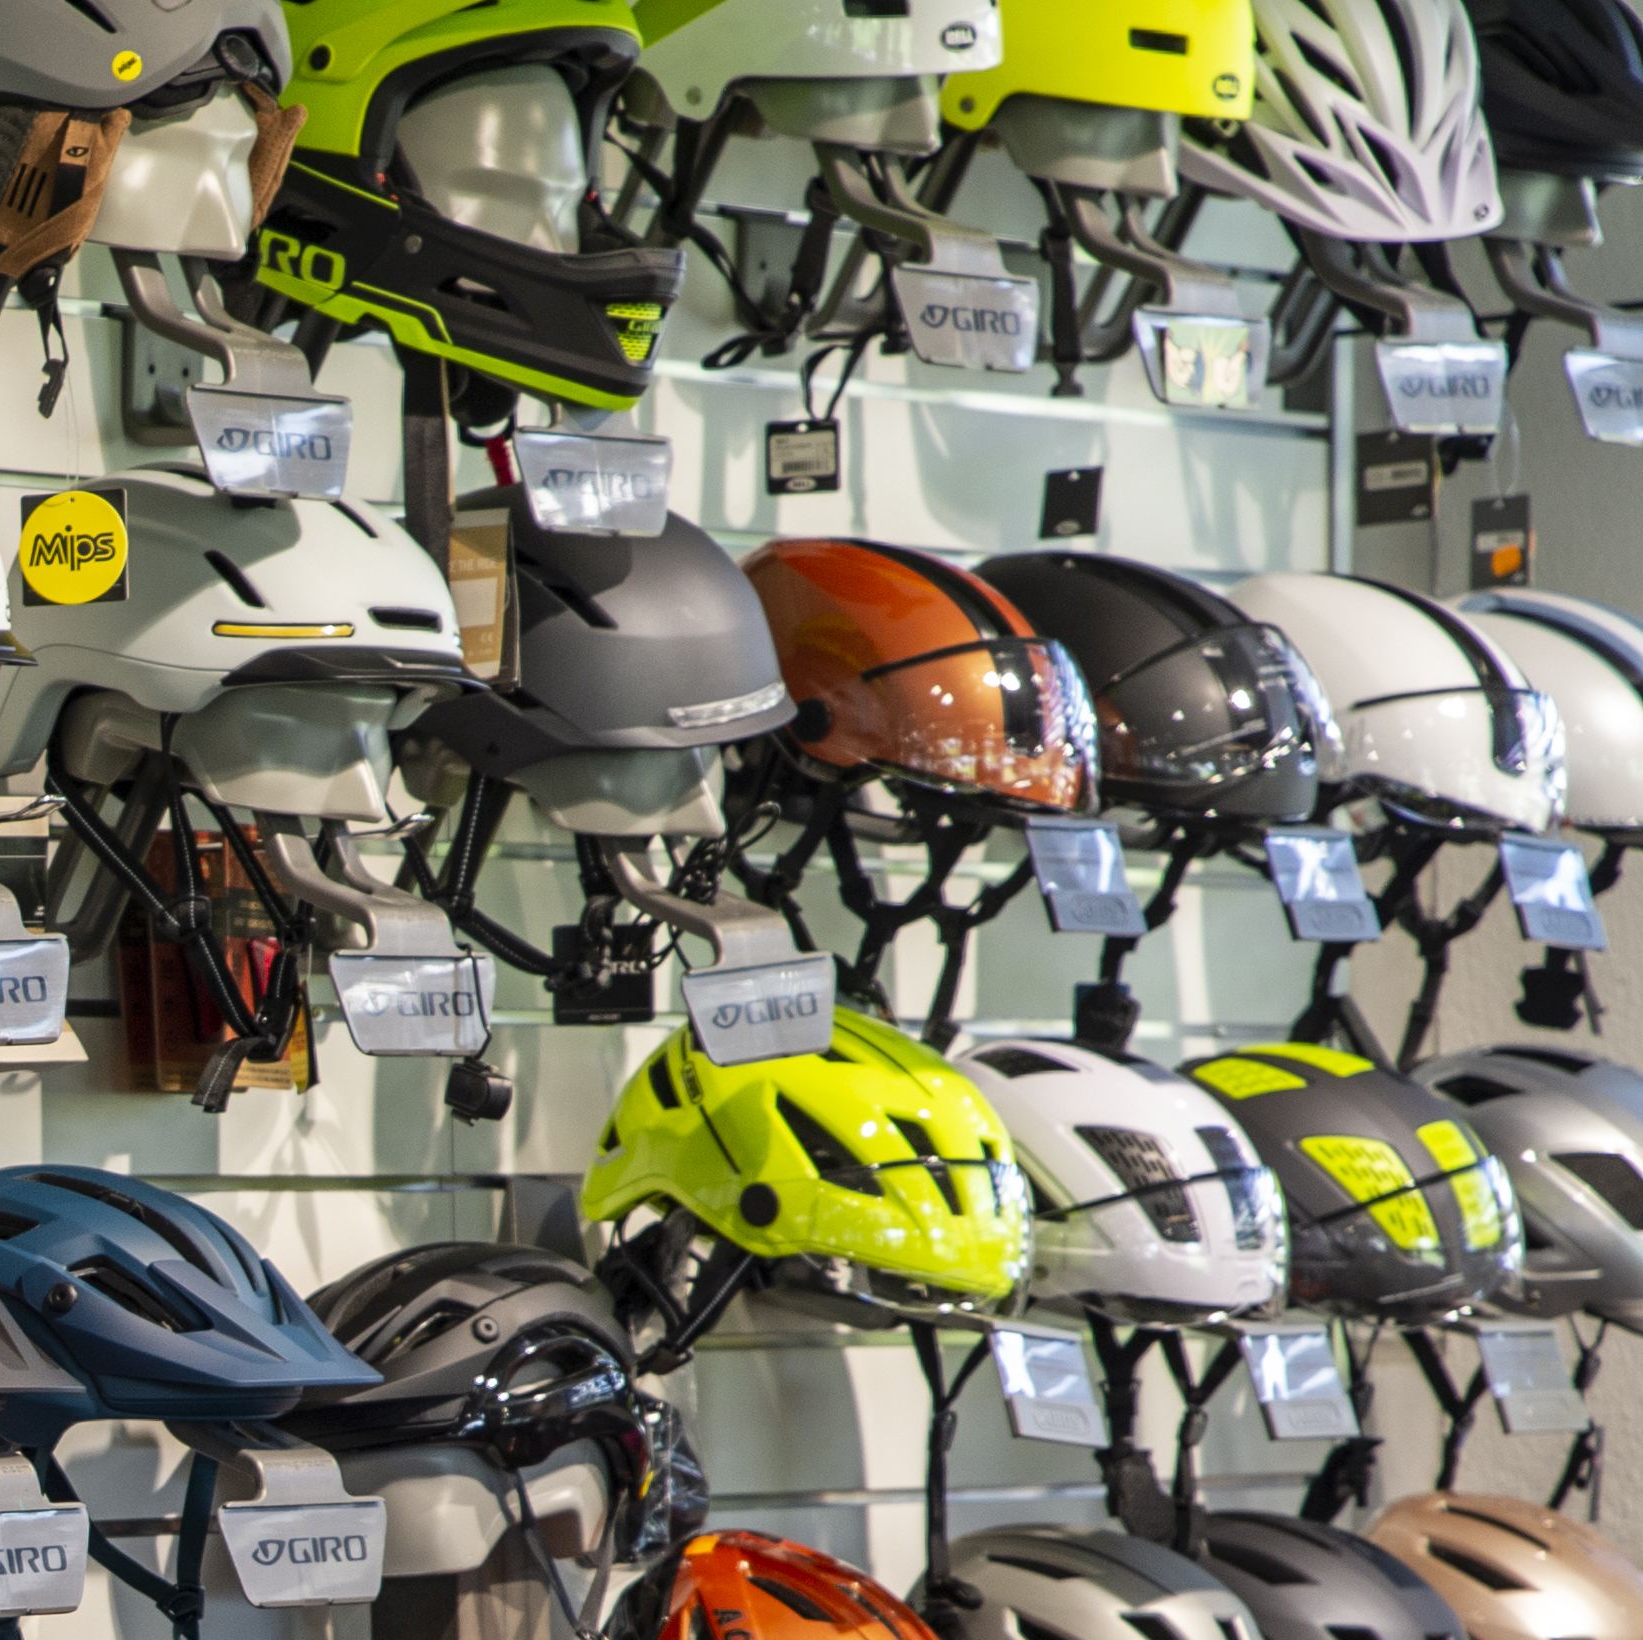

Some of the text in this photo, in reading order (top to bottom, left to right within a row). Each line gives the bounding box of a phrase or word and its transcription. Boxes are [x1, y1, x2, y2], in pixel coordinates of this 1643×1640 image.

[260, 228, 346, 291] RO
[952, 309, 1021, 336] GIRO
[254, 434, 331, 461] GIRO
[29, 525, 115, 571] Mips
[396, 991, 473, 1018] GIRO
[745, 992, 816, 1018] GIRO
[290, 1536, 367, 1564] GIRO
